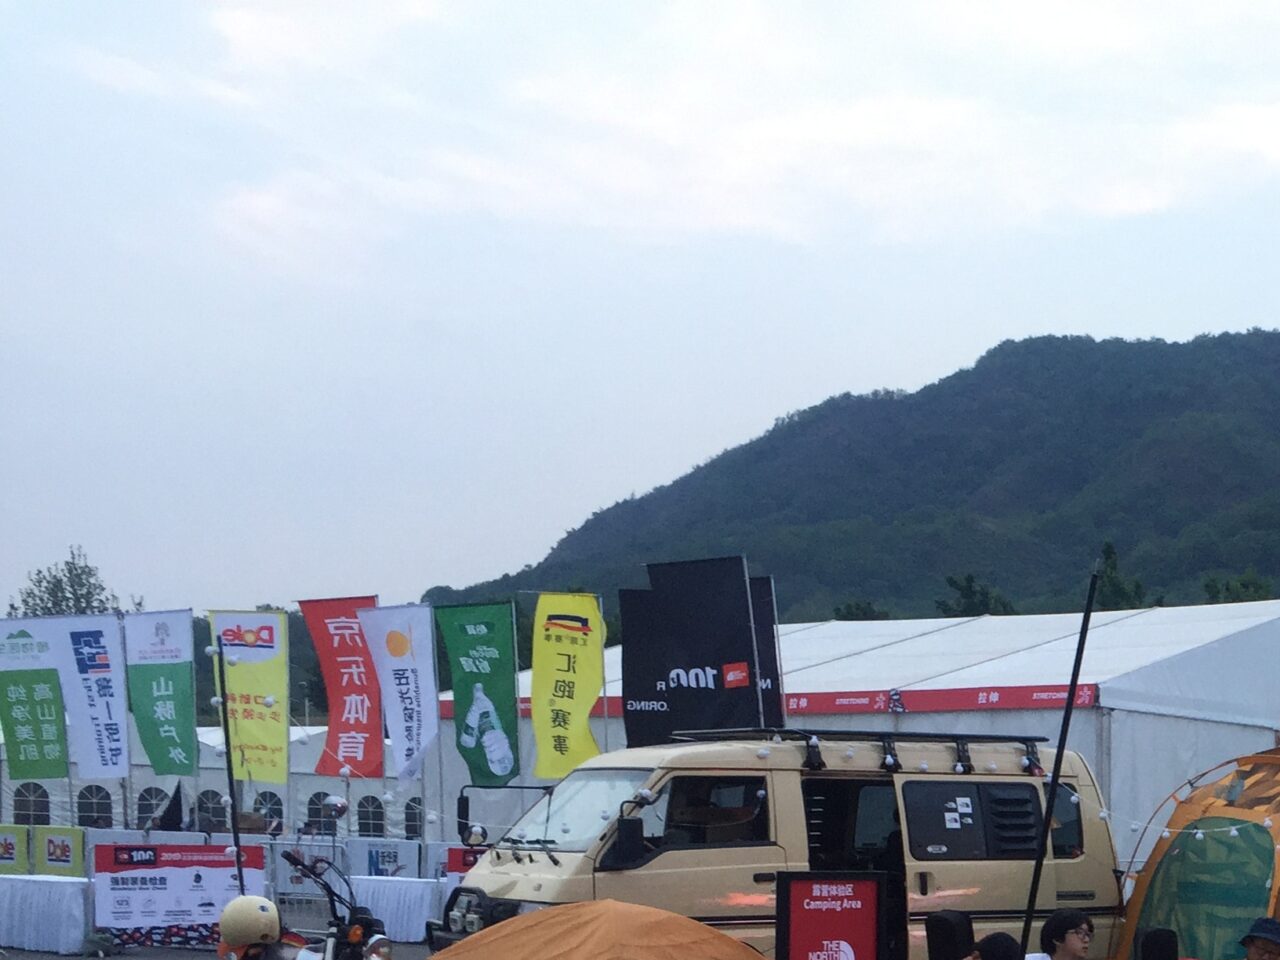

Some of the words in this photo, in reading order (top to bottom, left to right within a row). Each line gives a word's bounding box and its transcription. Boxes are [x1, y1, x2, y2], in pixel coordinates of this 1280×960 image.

[977, 691, 1000, 704] 拉伸
[1032, 691, 1070, 700] STRETCHIN
[789, 697, 808, 709] 拉伸
[47, 838, 71, 859] Dole
[803, 897, 842, 912] Camping
[842, 897, 862, 909] Area
[822, 940, 840, 952] THE
